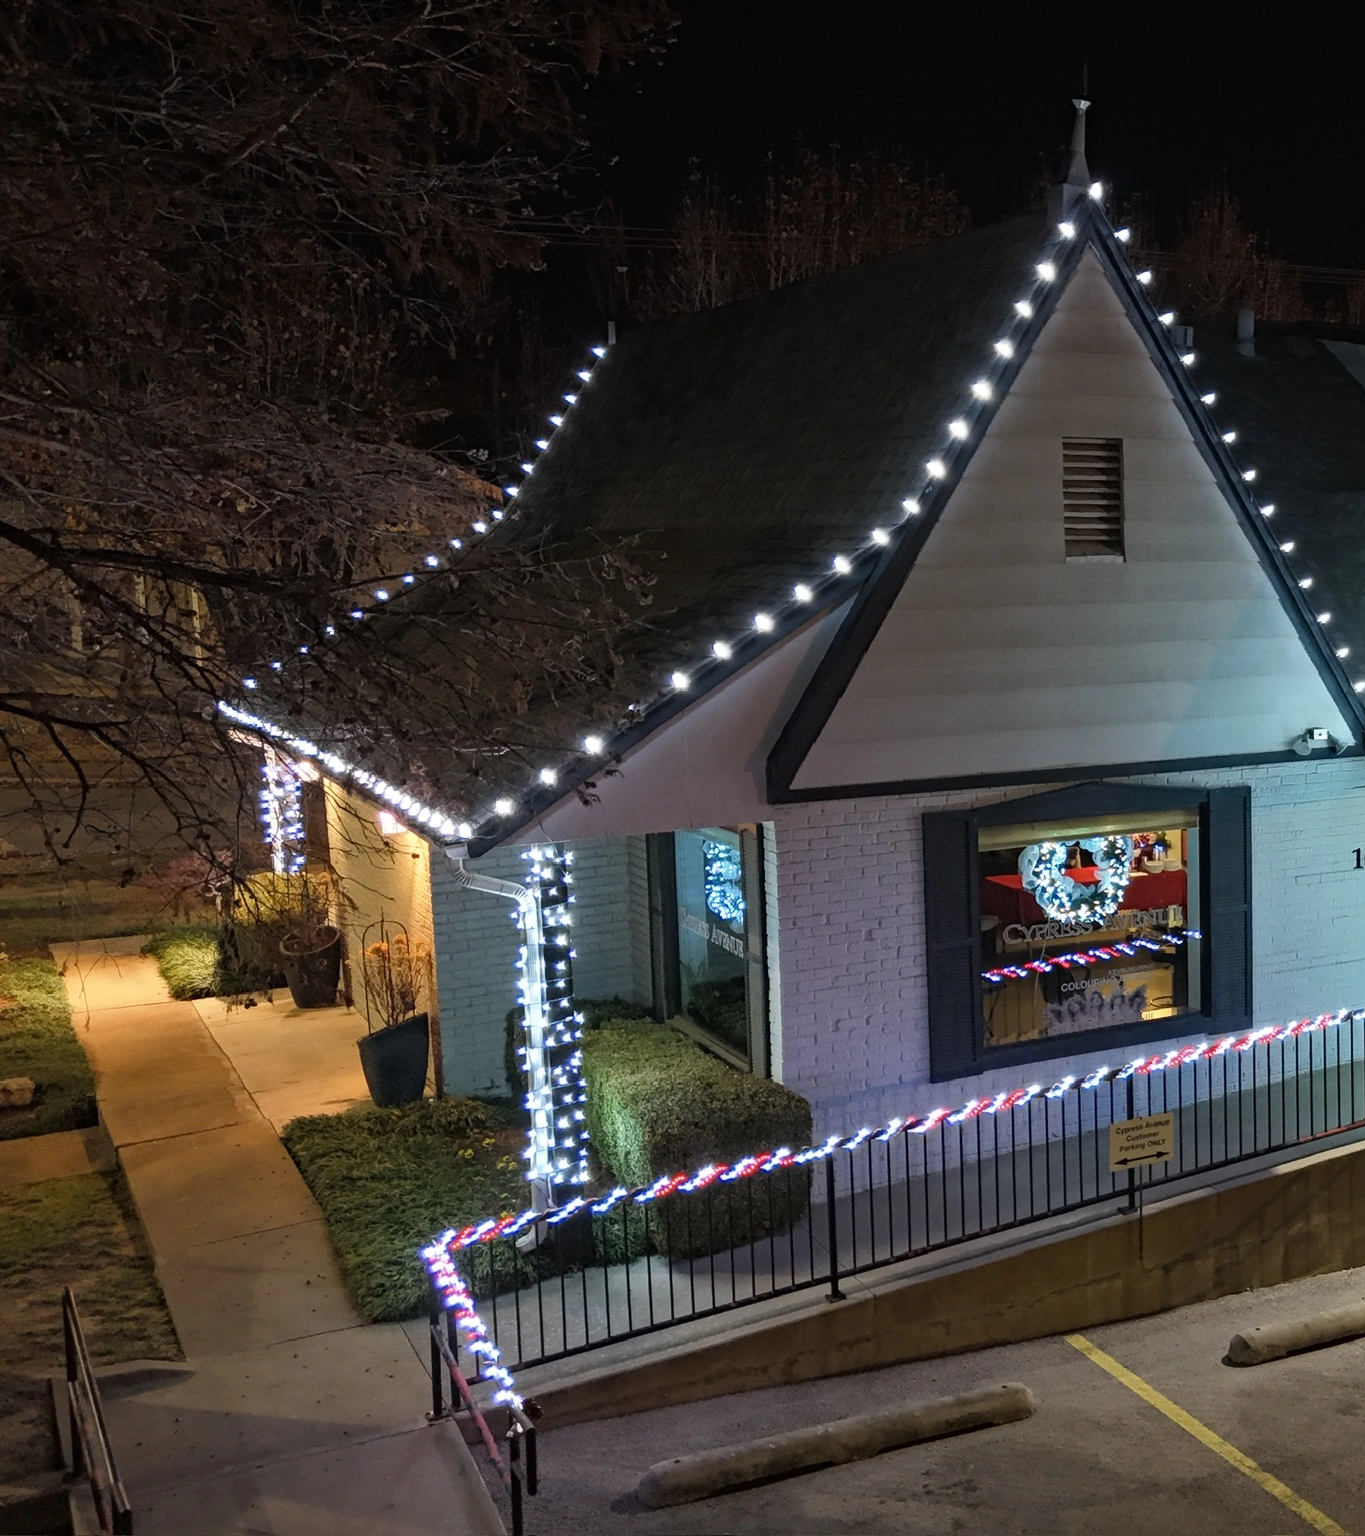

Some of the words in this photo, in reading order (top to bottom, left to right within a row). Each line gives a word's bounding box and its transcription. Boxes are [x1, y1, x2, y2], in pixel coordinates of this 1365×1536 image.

[1003, 917, 1093, 944] CYPRESS
[1101, 904, 1183, 931] AVENUE
[1115, 1124, 1143, 1136] Cypress
[1145, 1119, 1170, 1129] Avenue
[1126, 1131, 1160, 1142] Customer
[1119, 1142, 1146, 1153] Parking
[1147, 1138, 1166, 1147] ONLY
